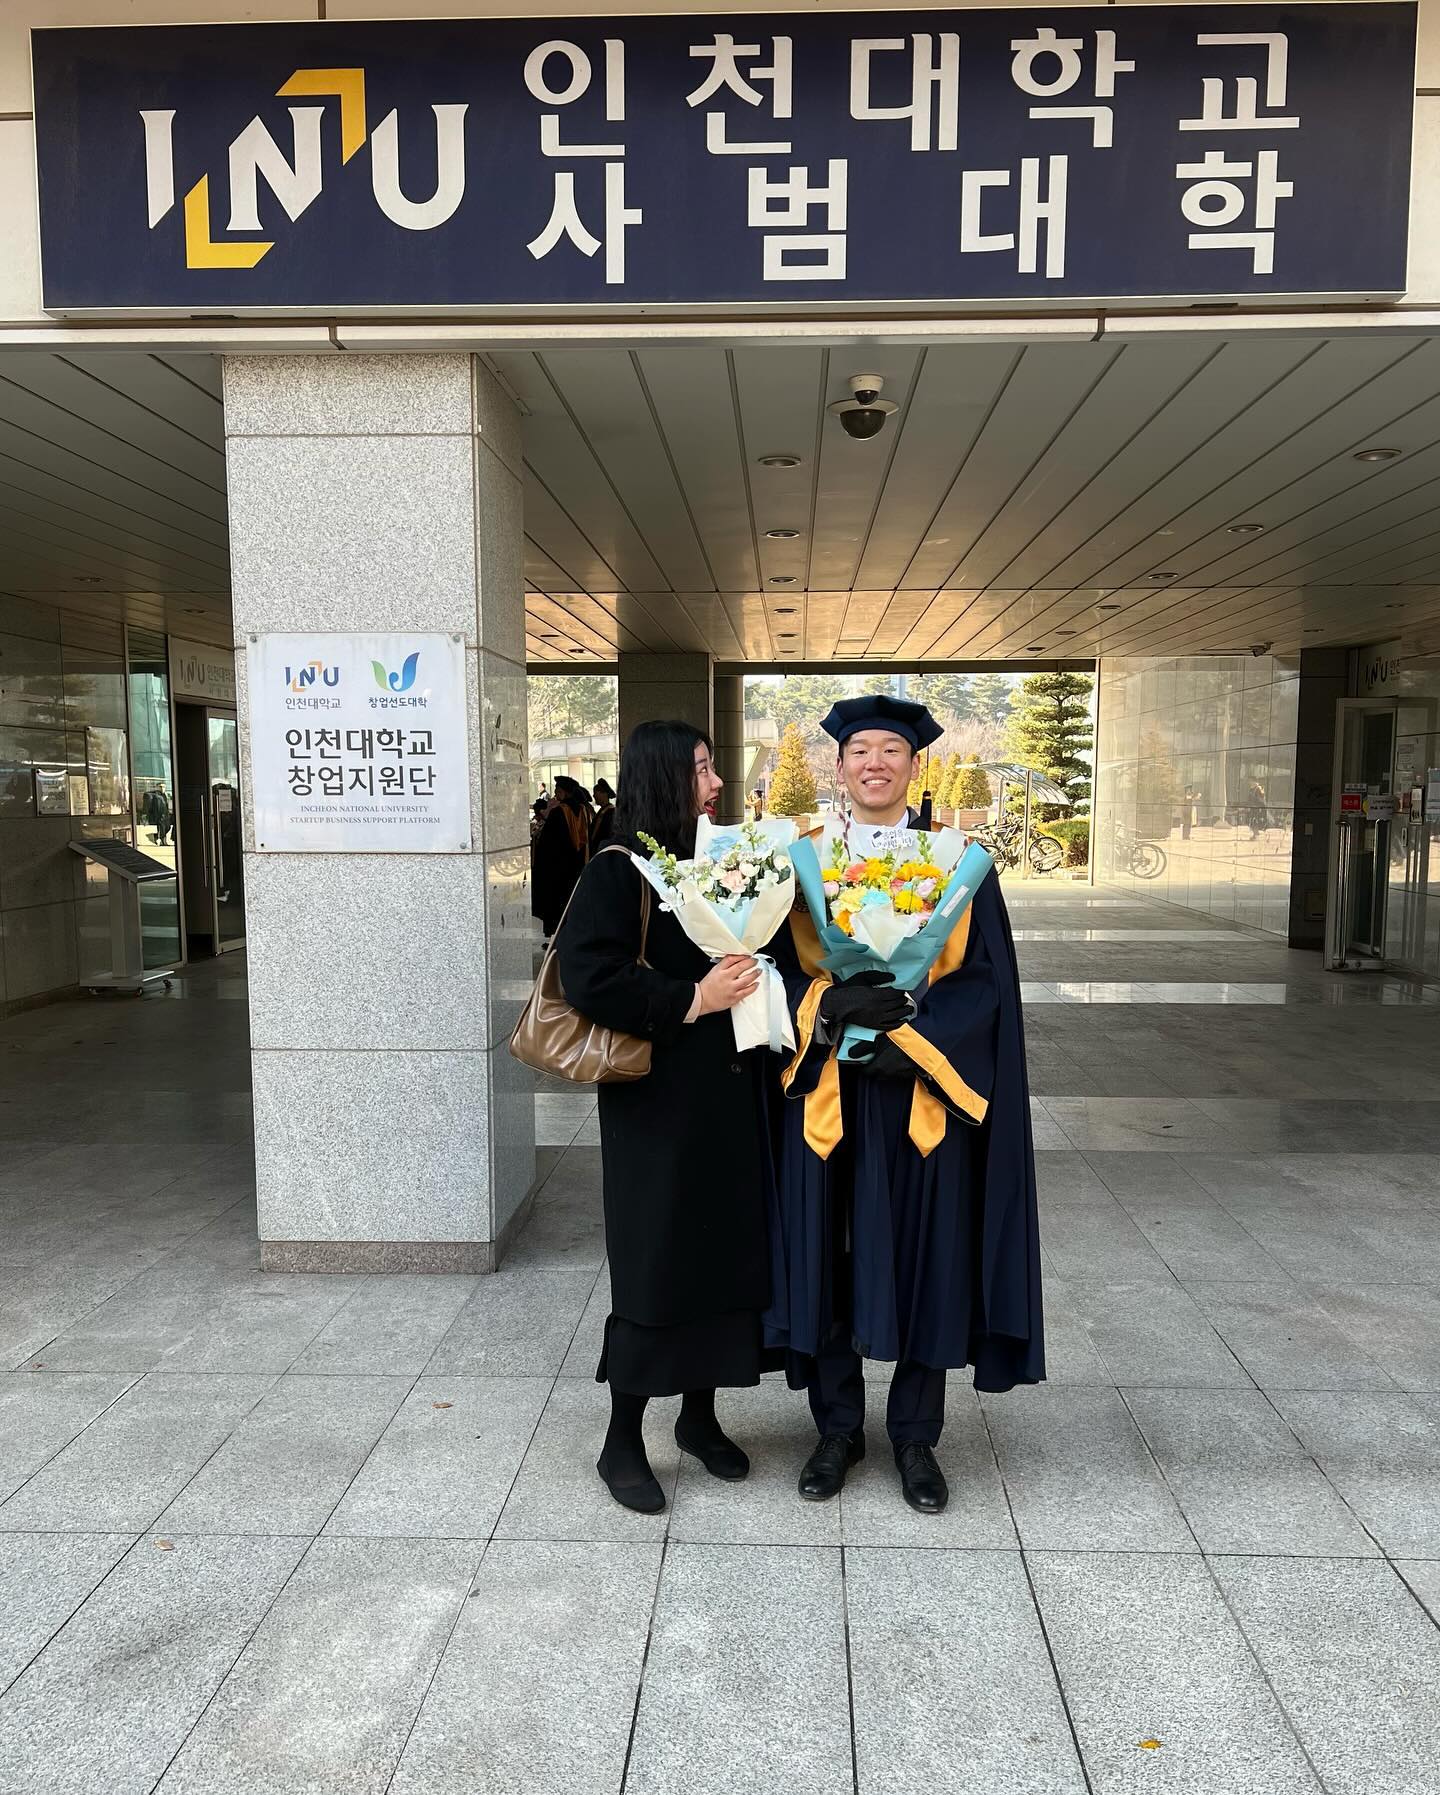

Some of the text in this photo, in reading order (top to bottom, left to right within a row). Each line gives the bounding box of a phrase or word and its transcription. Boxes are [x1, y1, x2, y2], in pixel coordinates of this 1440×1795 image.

[524, 27, 1300, 156] 인천대학교
[139, 103, 469, 231] INU
[526, 149, 1294, 284] 사범대학
[180, 659, 205, 686] INU
[285, 666, 339, 687] INU
[285, 697, 342, 710] 인천대학교
[368, 696, 428, 709] 창업선도대학
[285, 728, 437, 760] 인천대학교
[287, 765, 437, 797] 창업지원단
[290, 816, 440, 824] STARTUP BUSINESS SUPPORT PLATFORM
[301, 805, 429, 813] INCHEON NATIONAL UNIVERSITY
